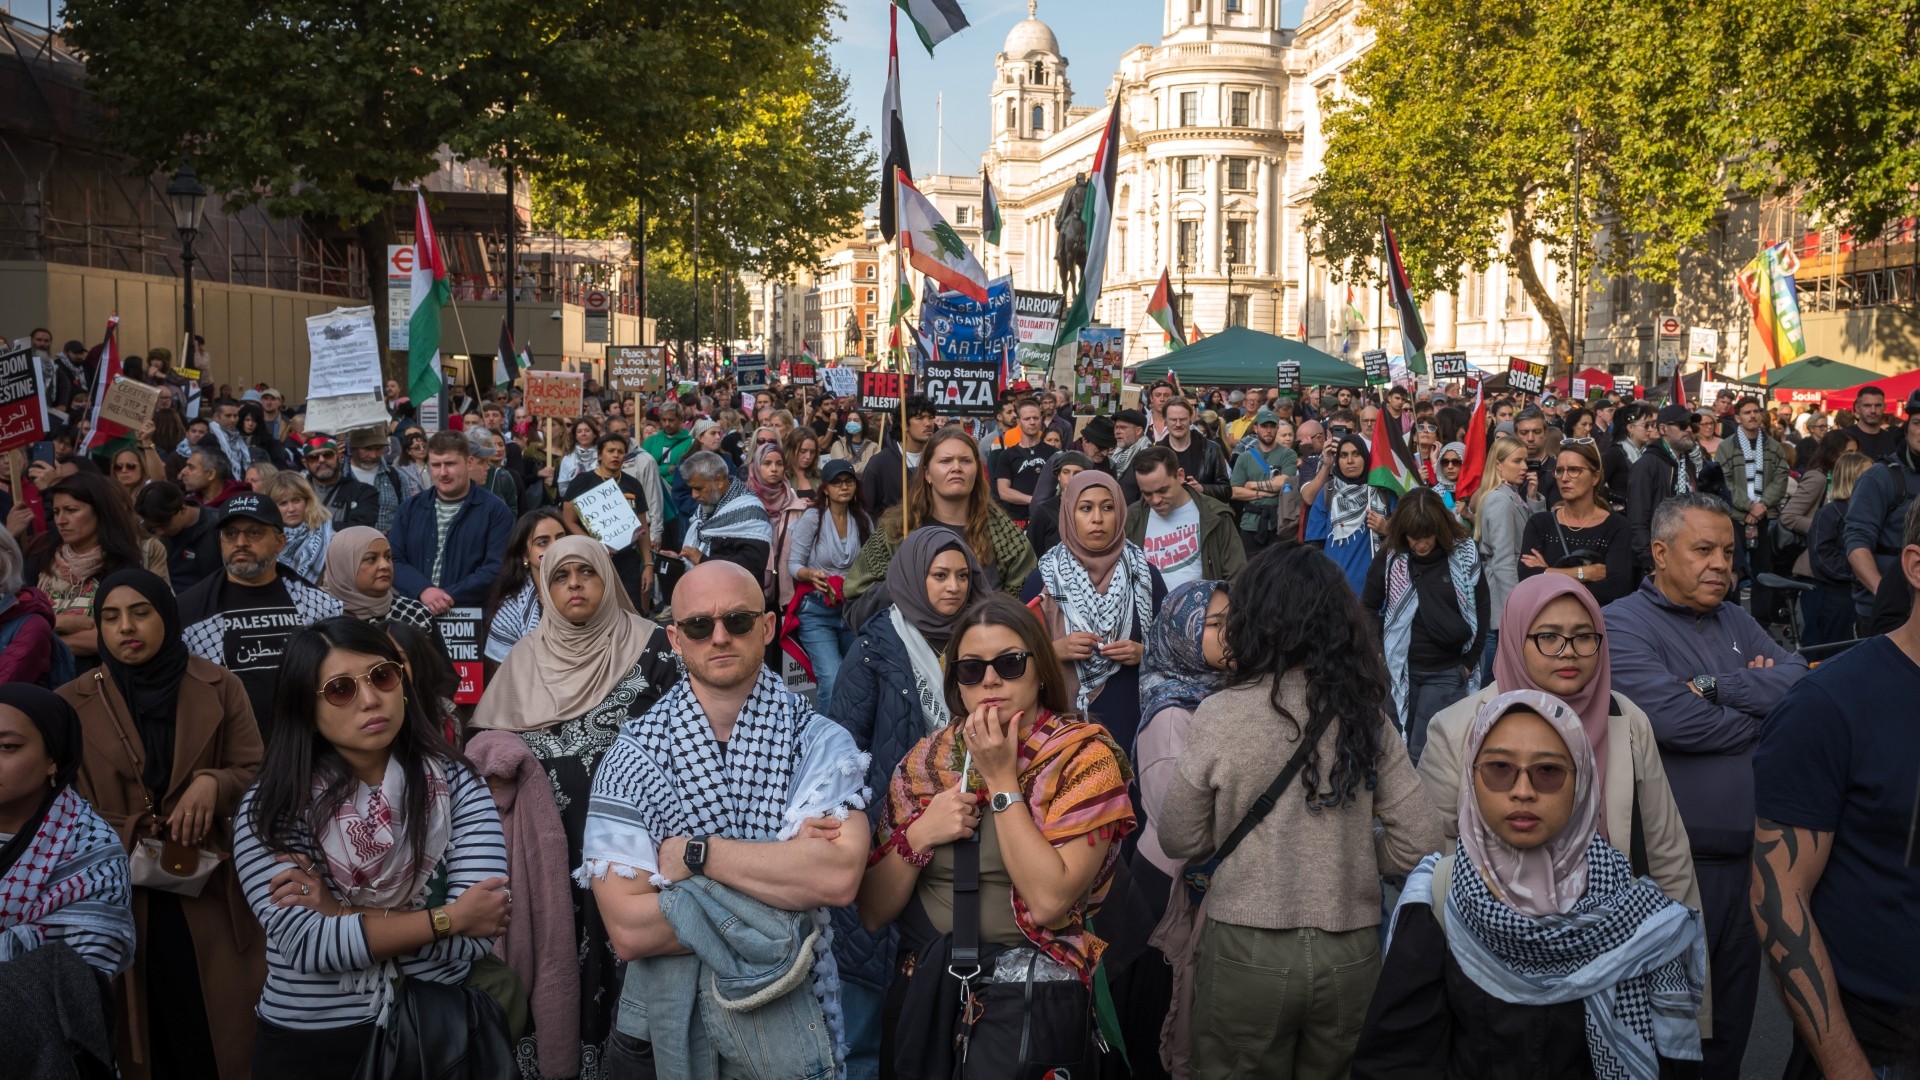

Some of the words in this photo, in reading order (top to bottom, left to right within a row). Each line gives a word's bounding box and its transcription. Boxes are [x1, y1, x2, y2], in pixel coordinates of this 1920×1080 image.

[988, 291, 1011, 309] FANS
[947, 312, 997, 325] AGAINST
[937, 335, 1014, 354] PARTHEID
[621, 348, 647, 357] Peace
[647, 358, 660, 366] the
[1434, 360, 1466, 375] GAZA
[1512, 359, 1527, 372] END
[1529, 363, 1545, 377] THE
[613, 366, 649, 375] absence
[652, 368, 662, 377] of
[793, 364, 812, 377] FREE
[927, 367, 951, 379] Stop
[953, 368, 994, 380] Starving
[527, 377, 581, 399] Palestine
[864, 373, 909, 398] FREE
[1508, 368, 1542, 393] SIEGE
[117, 383, 153, 399] CEASEFIRE
[927, 380, 993, 405] GAZA
[1727, 383, 1742, 392] Stop
[1742, 385, 1767, 395] Starving
[1792, 391, 1821, 401] Sociali
[107, 404, 120, 414] FREE
[115, 394, 122, 402] IS
[123, 399, 140, 410] STEP
[142, 405, 148, 414] 1
[527, 400, 579, 416] forever
[863, 396, 902, 408] PALESTI
[575, 495, 596, 511] DID
[597, 484, 618, 500] YOU
[601, 499, 622, 513] ALL
[599, 514, 621, 529] YOU
[224, 613, 304, 631] PALESTINE
[438, 622, 475, 637] EDOM
[236, 638, 288, 663] سطين
[447, 644, 478, 660] STINE
